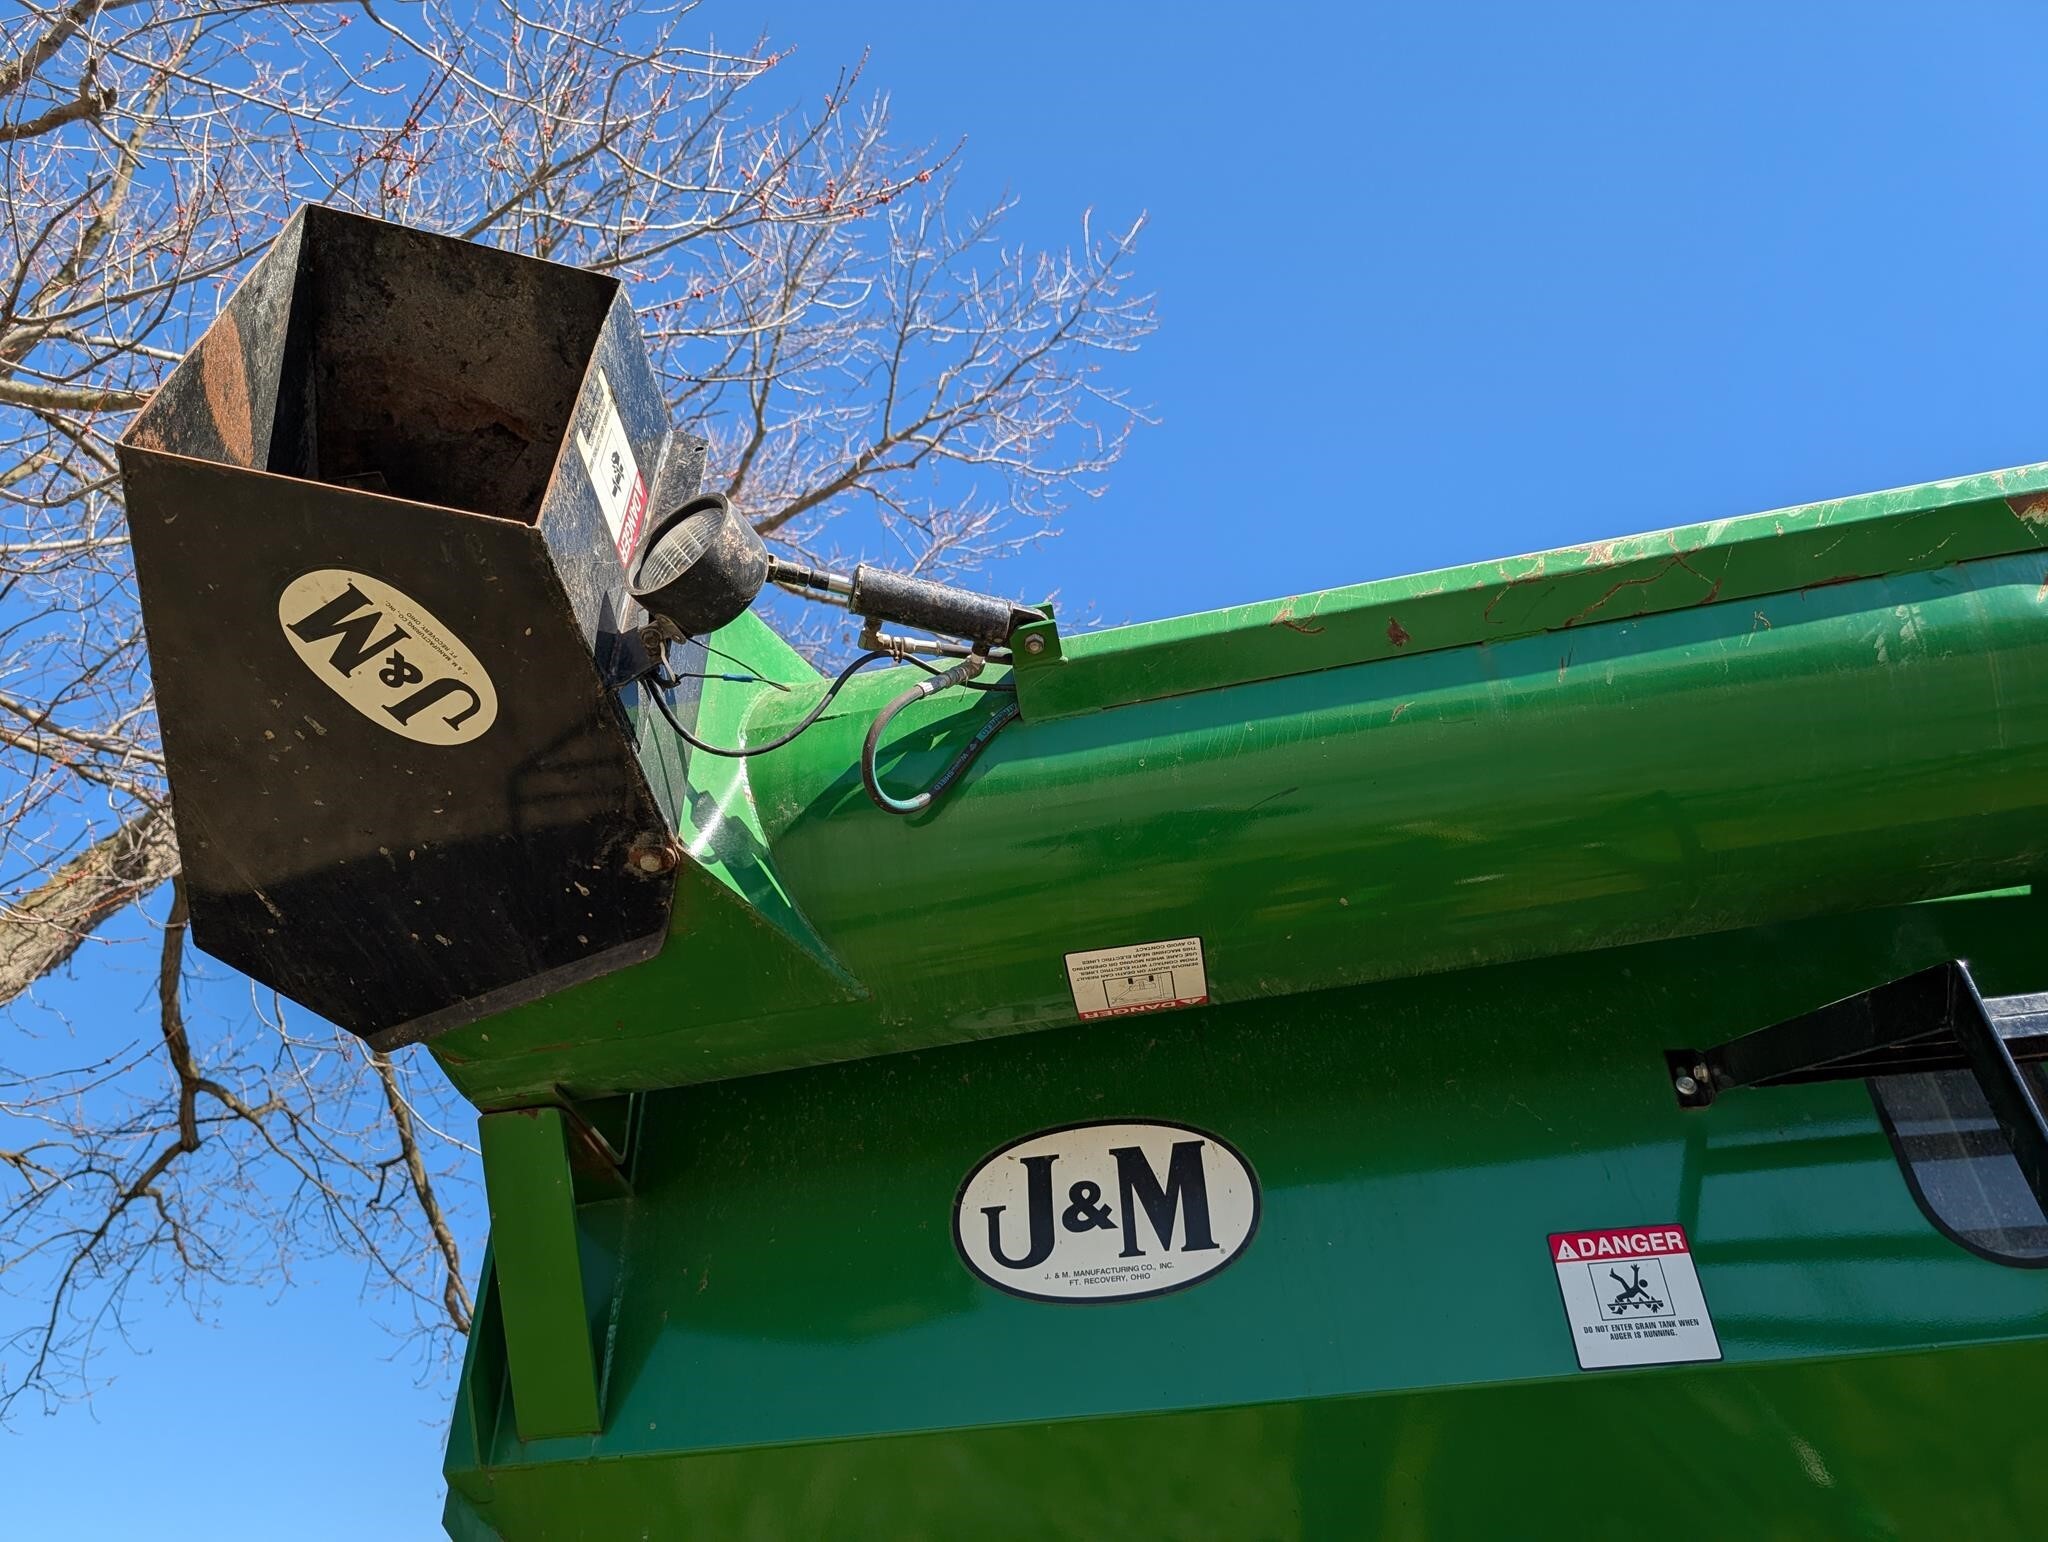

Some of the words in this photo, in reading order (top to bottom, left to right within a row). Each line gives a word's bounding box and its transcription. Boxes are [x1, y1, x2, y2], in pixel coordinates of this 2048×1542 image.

[619, 489, 641, 564] DANGER
[386, 600, 396, 612] INC.
[407, 613, 421, 625] OHIO
[408, 622, 451, 661] MANUFACTURING
[286, 583, 481, 731] J&M
[1084, 1002, 1176, 1019] DANGER
[980, 1140, 1220, 1270] J&M
[1577, 1231, 1684, 1257] DANGER
[1073, 1265, 1139, 1277] MANUFACTURING
[1084, 1275, 1128, 1285] RECOVERY,
[1611, 1323, 1633, 1331] ENTER
[1635, 1321, 1657, 1330] GRAIN
[1658, 1320, 1676, 1328] TANK
[1610, 1332, 1632, 1340] AUGER
[1644, 1329, 1678, 1337] RUNNING.
